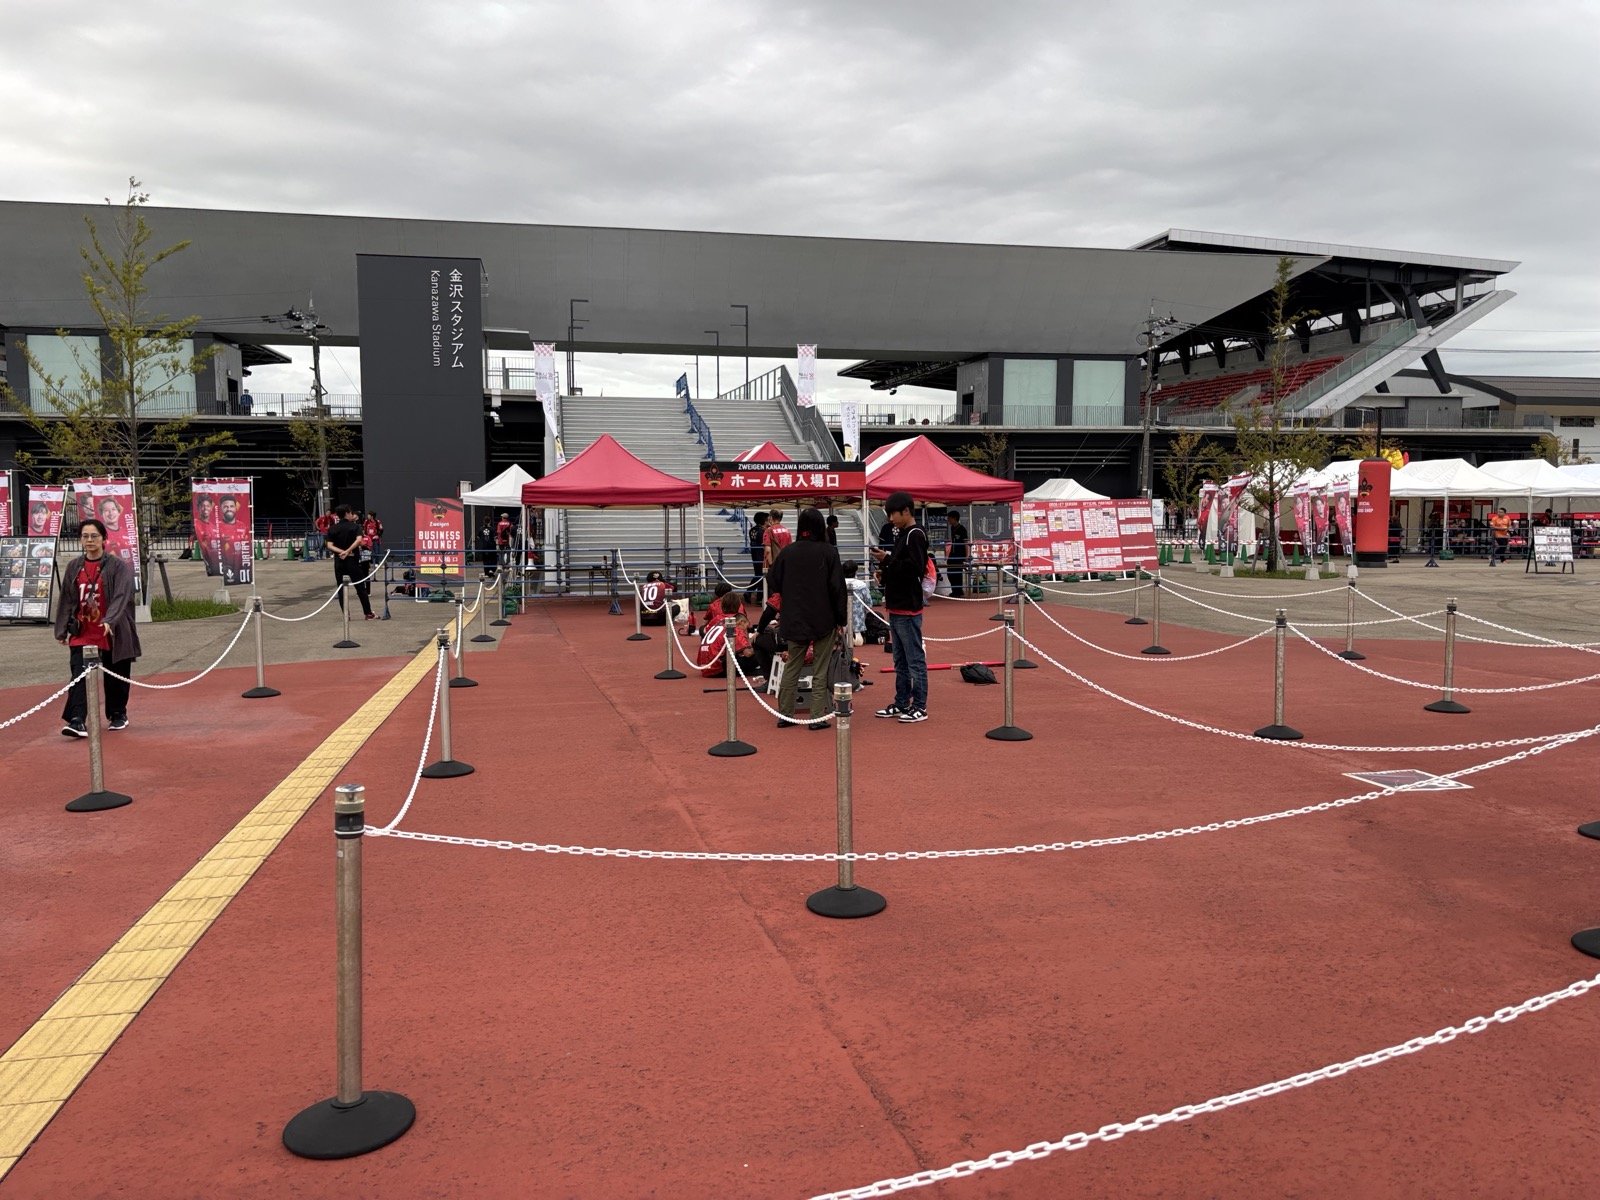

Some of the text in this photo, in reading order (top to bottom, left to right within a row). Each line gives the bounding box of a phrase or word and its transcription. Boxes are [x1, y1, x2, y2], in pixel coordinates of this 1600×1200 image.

[430, 270, 442, 367] Kanazawa Stadium
[449, 268, 464, 368] 金沢スタジアム
[731, 474, 840, 488] ホーム南入場口
[418, 531, 461, 540] BUSINESS
[422, 540, 457, 549] LOUNGE
[643, 586, 658, 601] 10
[701, 625, 724, 645] 10
